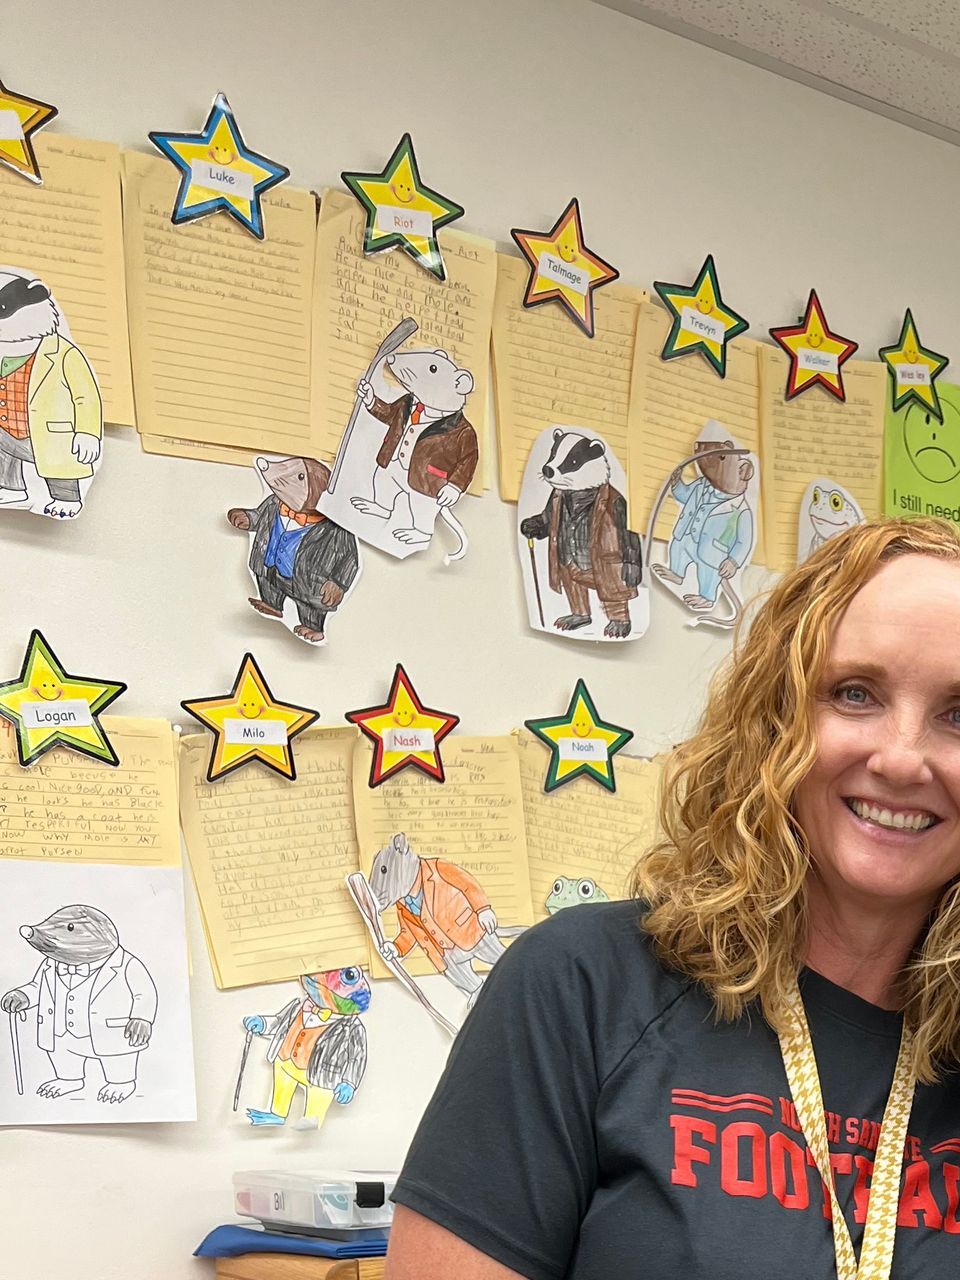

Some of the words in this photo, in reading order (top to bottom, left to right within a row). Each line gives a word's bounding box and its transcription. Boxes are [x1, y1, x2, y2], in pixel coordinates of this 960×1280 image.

[208, 167, 236, 186] Luke
[393, 216, 414, 229] Riot
[547, 258, 582, 284] Talmage
[690, 316, 717, 336] Trevyn
[893, 489, 897, 505] I
[900, 491, 922, 514] still
[35, 709, 77, 725] Logan
[242, 727, 265, 739] Milo
[393, 735, 421, 746] Nash
[571, 742, 595, 752] Noah
